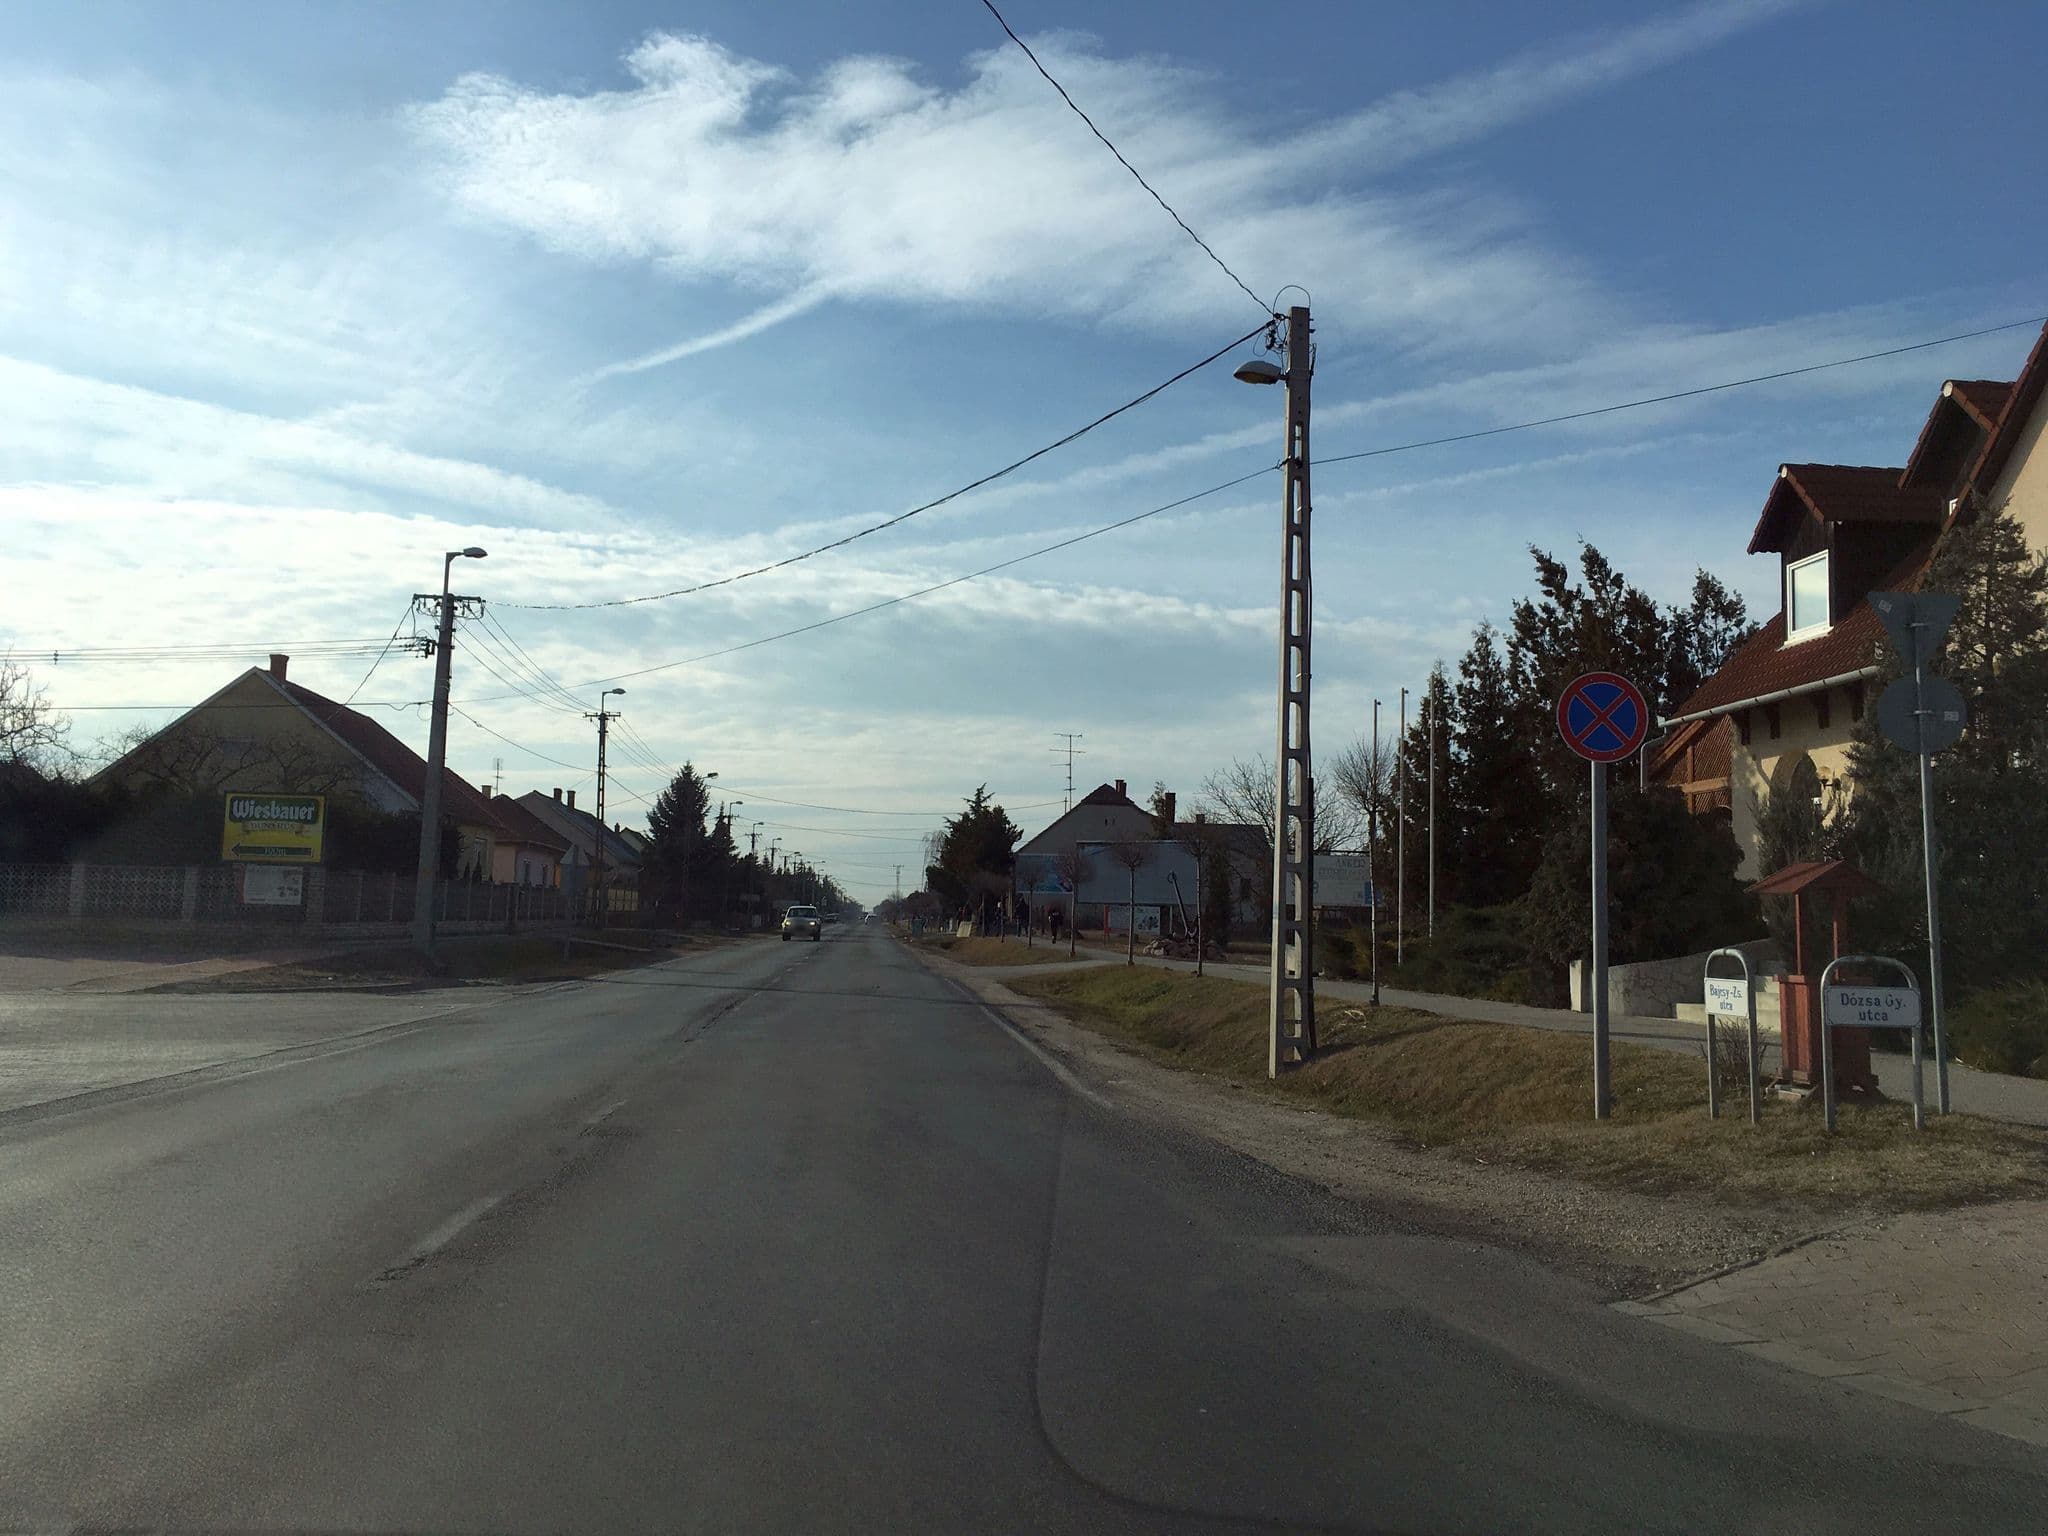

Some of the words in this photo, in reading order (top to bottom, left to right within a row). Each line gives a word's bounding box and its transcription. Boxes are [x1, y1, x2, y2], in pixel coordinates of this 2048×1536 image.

[232, 799, 315, 820] Wiesbauer
[1719, 1000, 1734, 1011] utca
[1840, 992, 1881, 1007] Dózsa
[1885, 993, 1907, 1010] Gy.
[1859, 1009, 1889, 1021] utca
